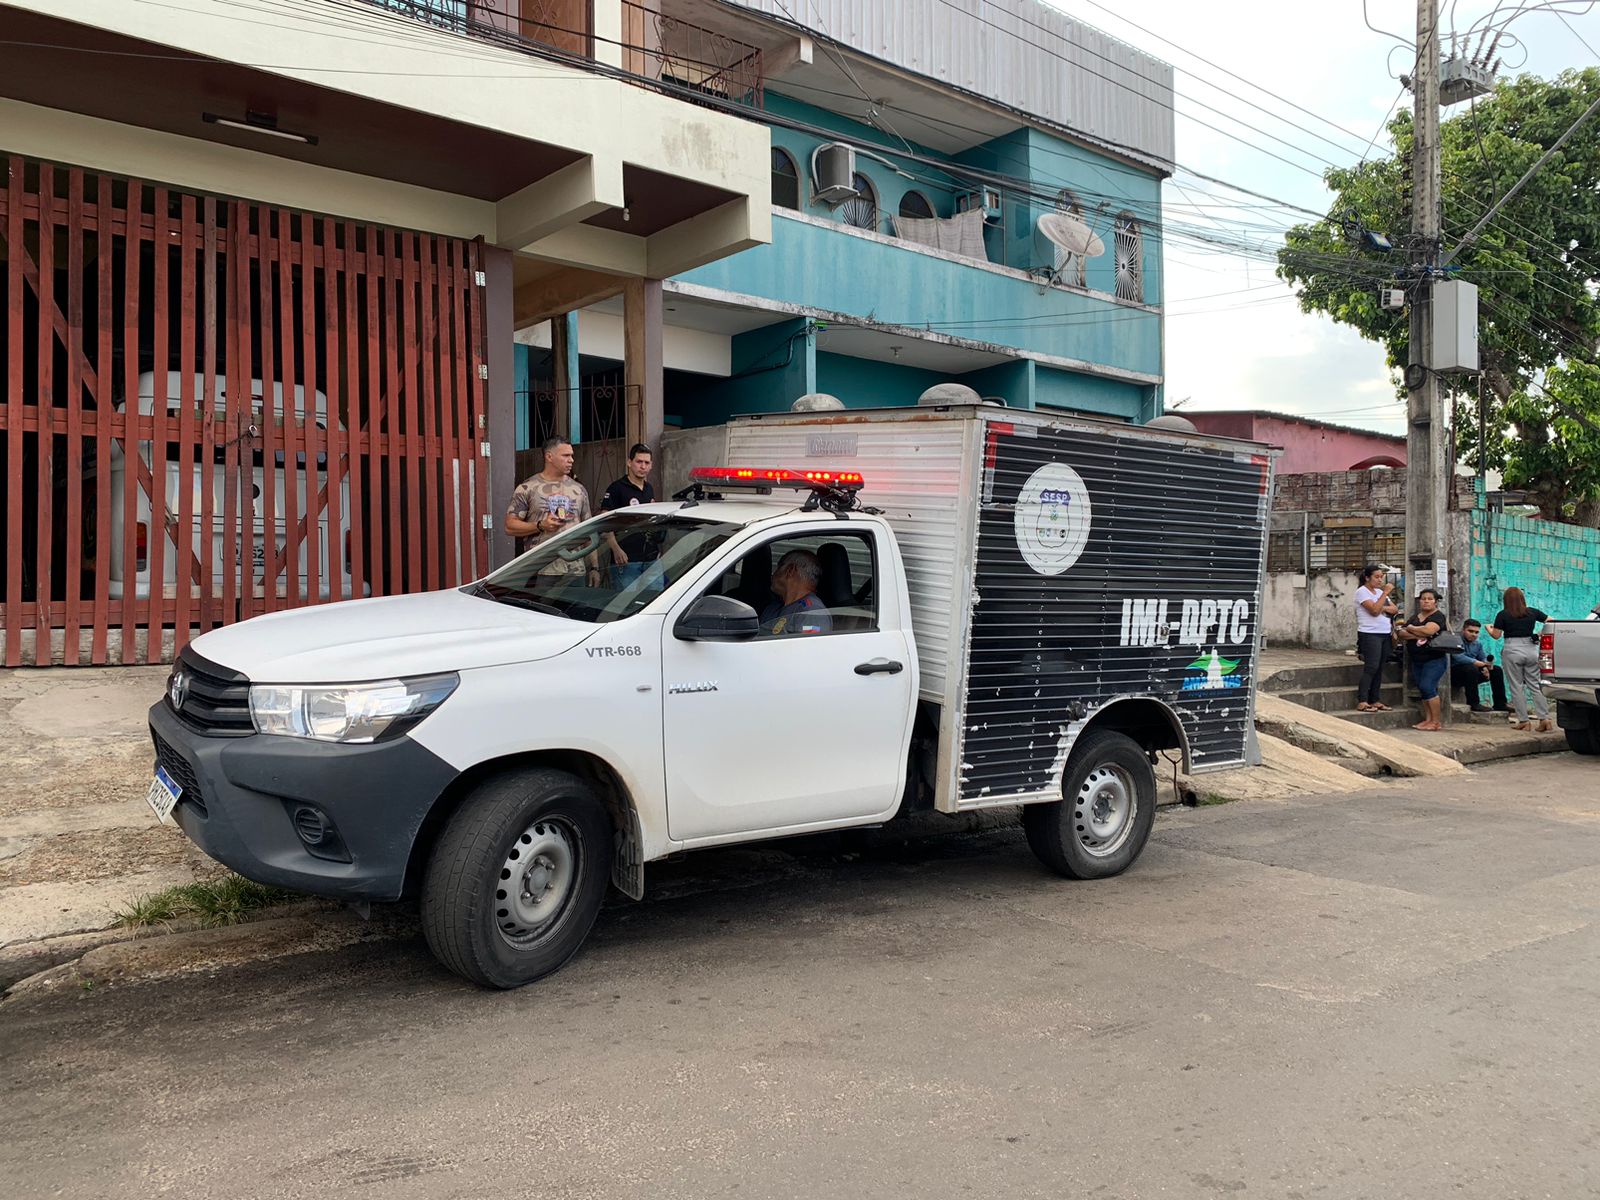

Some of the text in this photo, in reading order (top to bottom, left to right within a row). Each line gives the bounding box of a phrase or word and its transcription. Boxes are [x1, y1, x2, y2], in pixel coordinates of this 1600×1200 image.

[1043, 492, 1068, 502] SESP
[585, 645, 642, 658] VTR-668
[668, 680, 719, 694] HILUX
